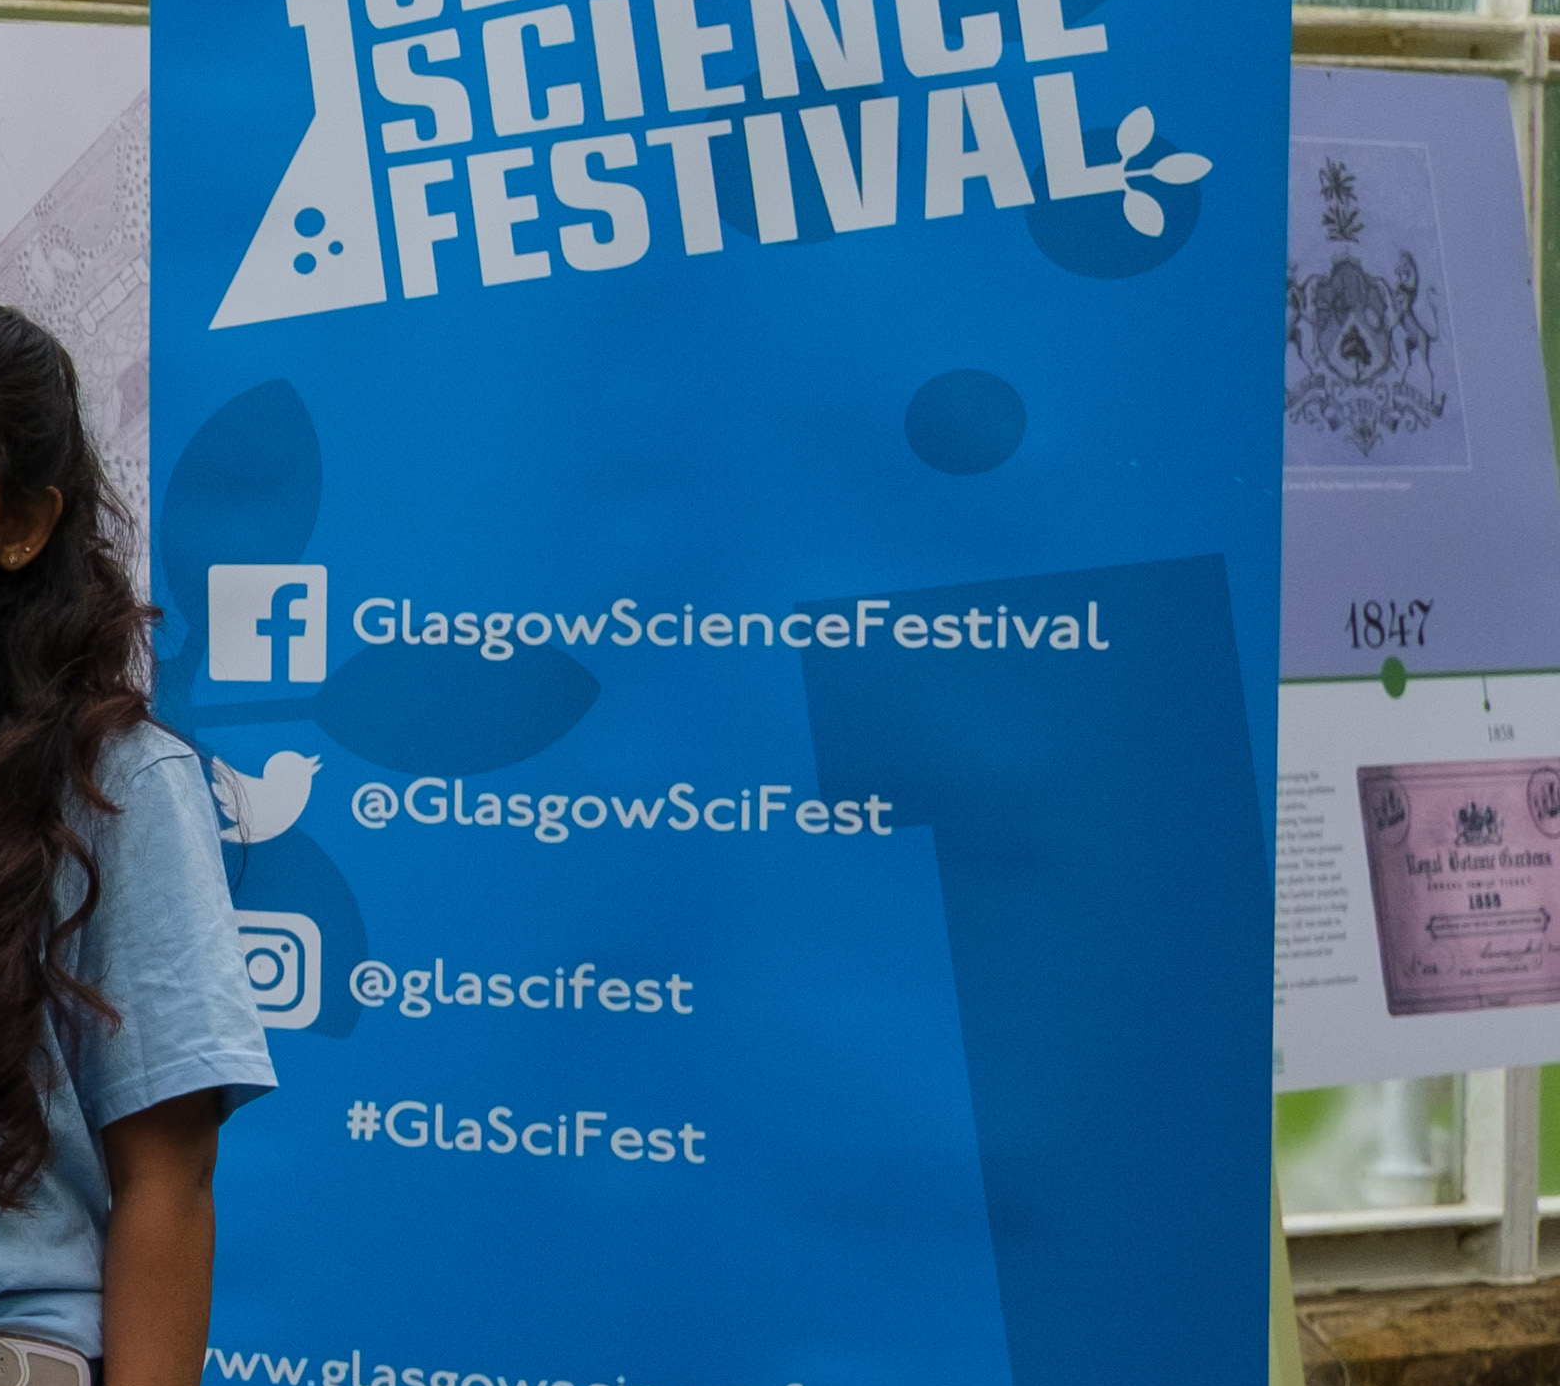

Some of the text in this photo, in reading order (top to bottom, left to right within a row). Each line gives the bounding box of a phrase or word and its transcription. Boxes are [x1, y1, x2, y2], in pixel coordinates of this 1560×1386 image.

[387, 71, 1126, 300] FESTIVAL
[351, 597, 1110, 661] GlasgowScienceFestival
[1345, 598, 1434, 649] 1847
[350, 776, 893, 844] @GlasgowSciFest
[348, 958, 694, 1018] @glascifest
[346, 1100, 707, 1163] #GlaSciFest
